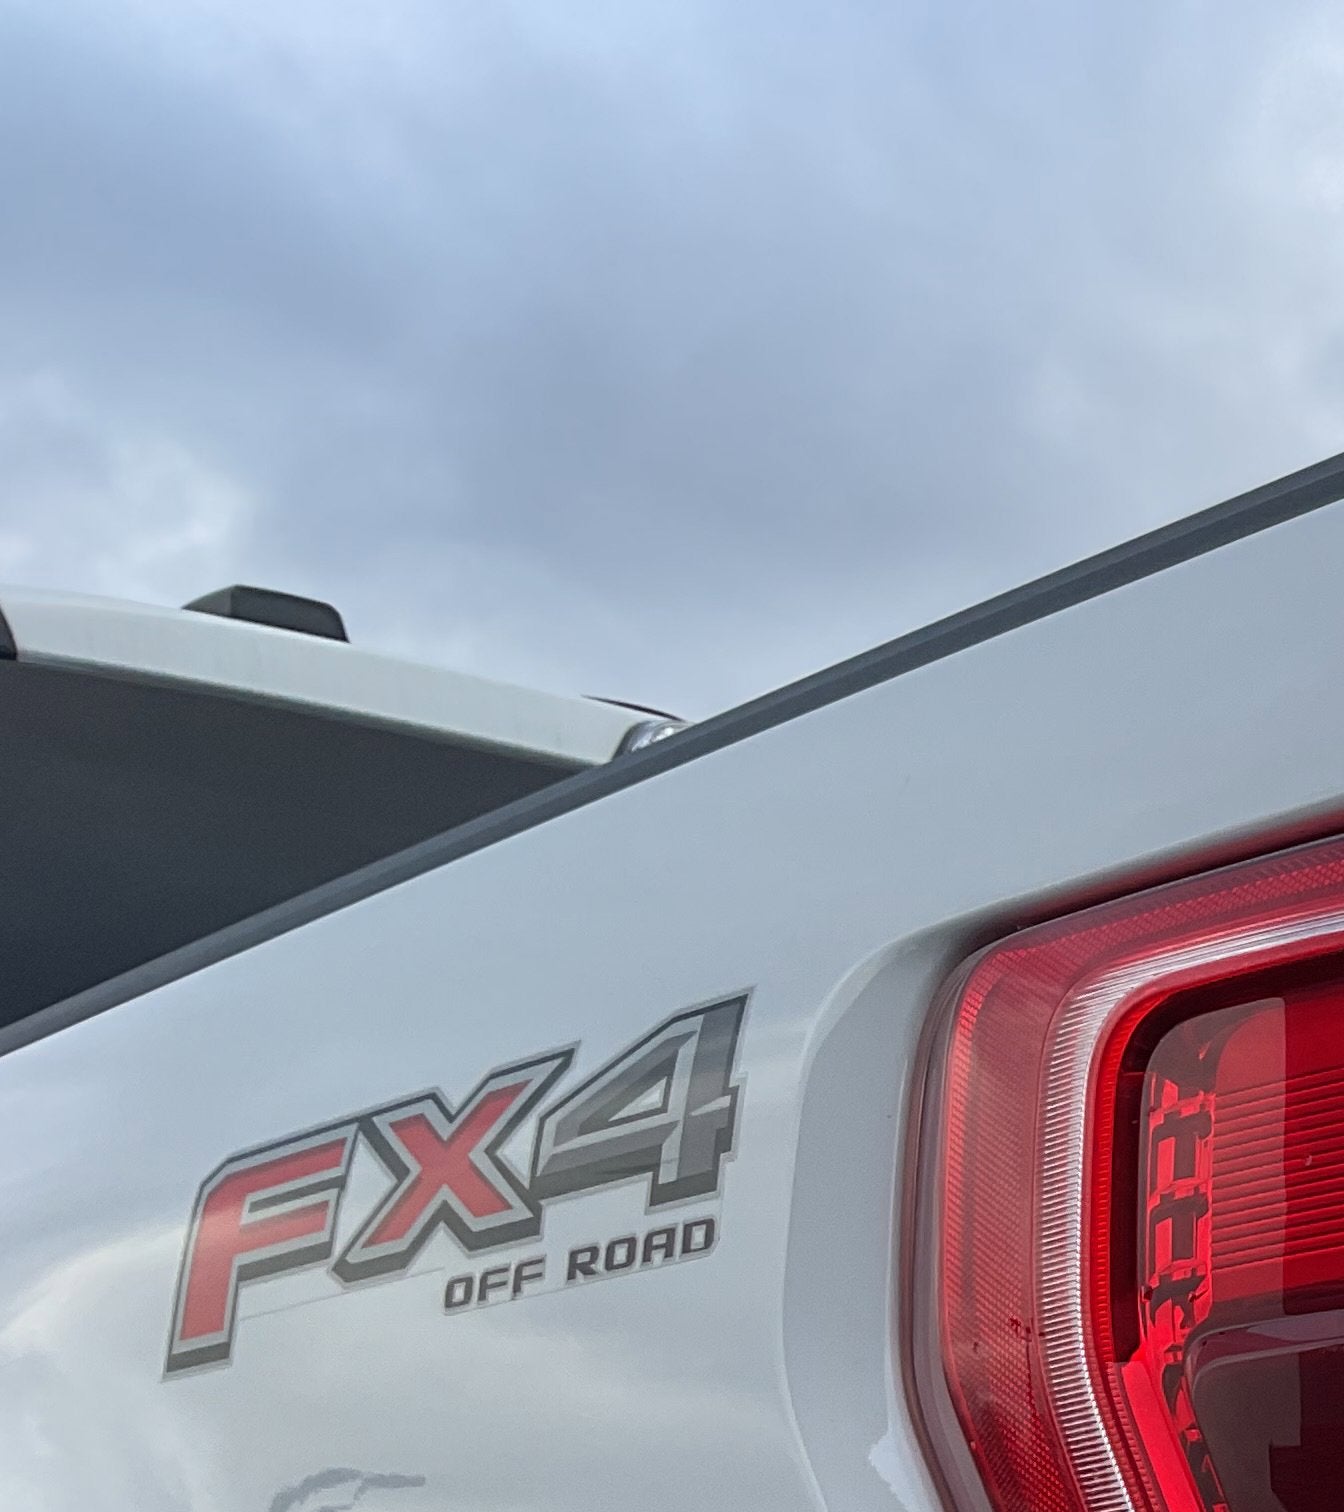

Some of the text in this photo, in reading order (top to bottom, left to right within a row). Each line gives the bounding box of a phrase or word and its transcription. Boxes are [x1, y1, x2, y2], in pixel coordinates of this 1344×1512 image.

[162, 986, 755, 1382] FX4
[443, 1217, 717, 1313] OFF ROAD
